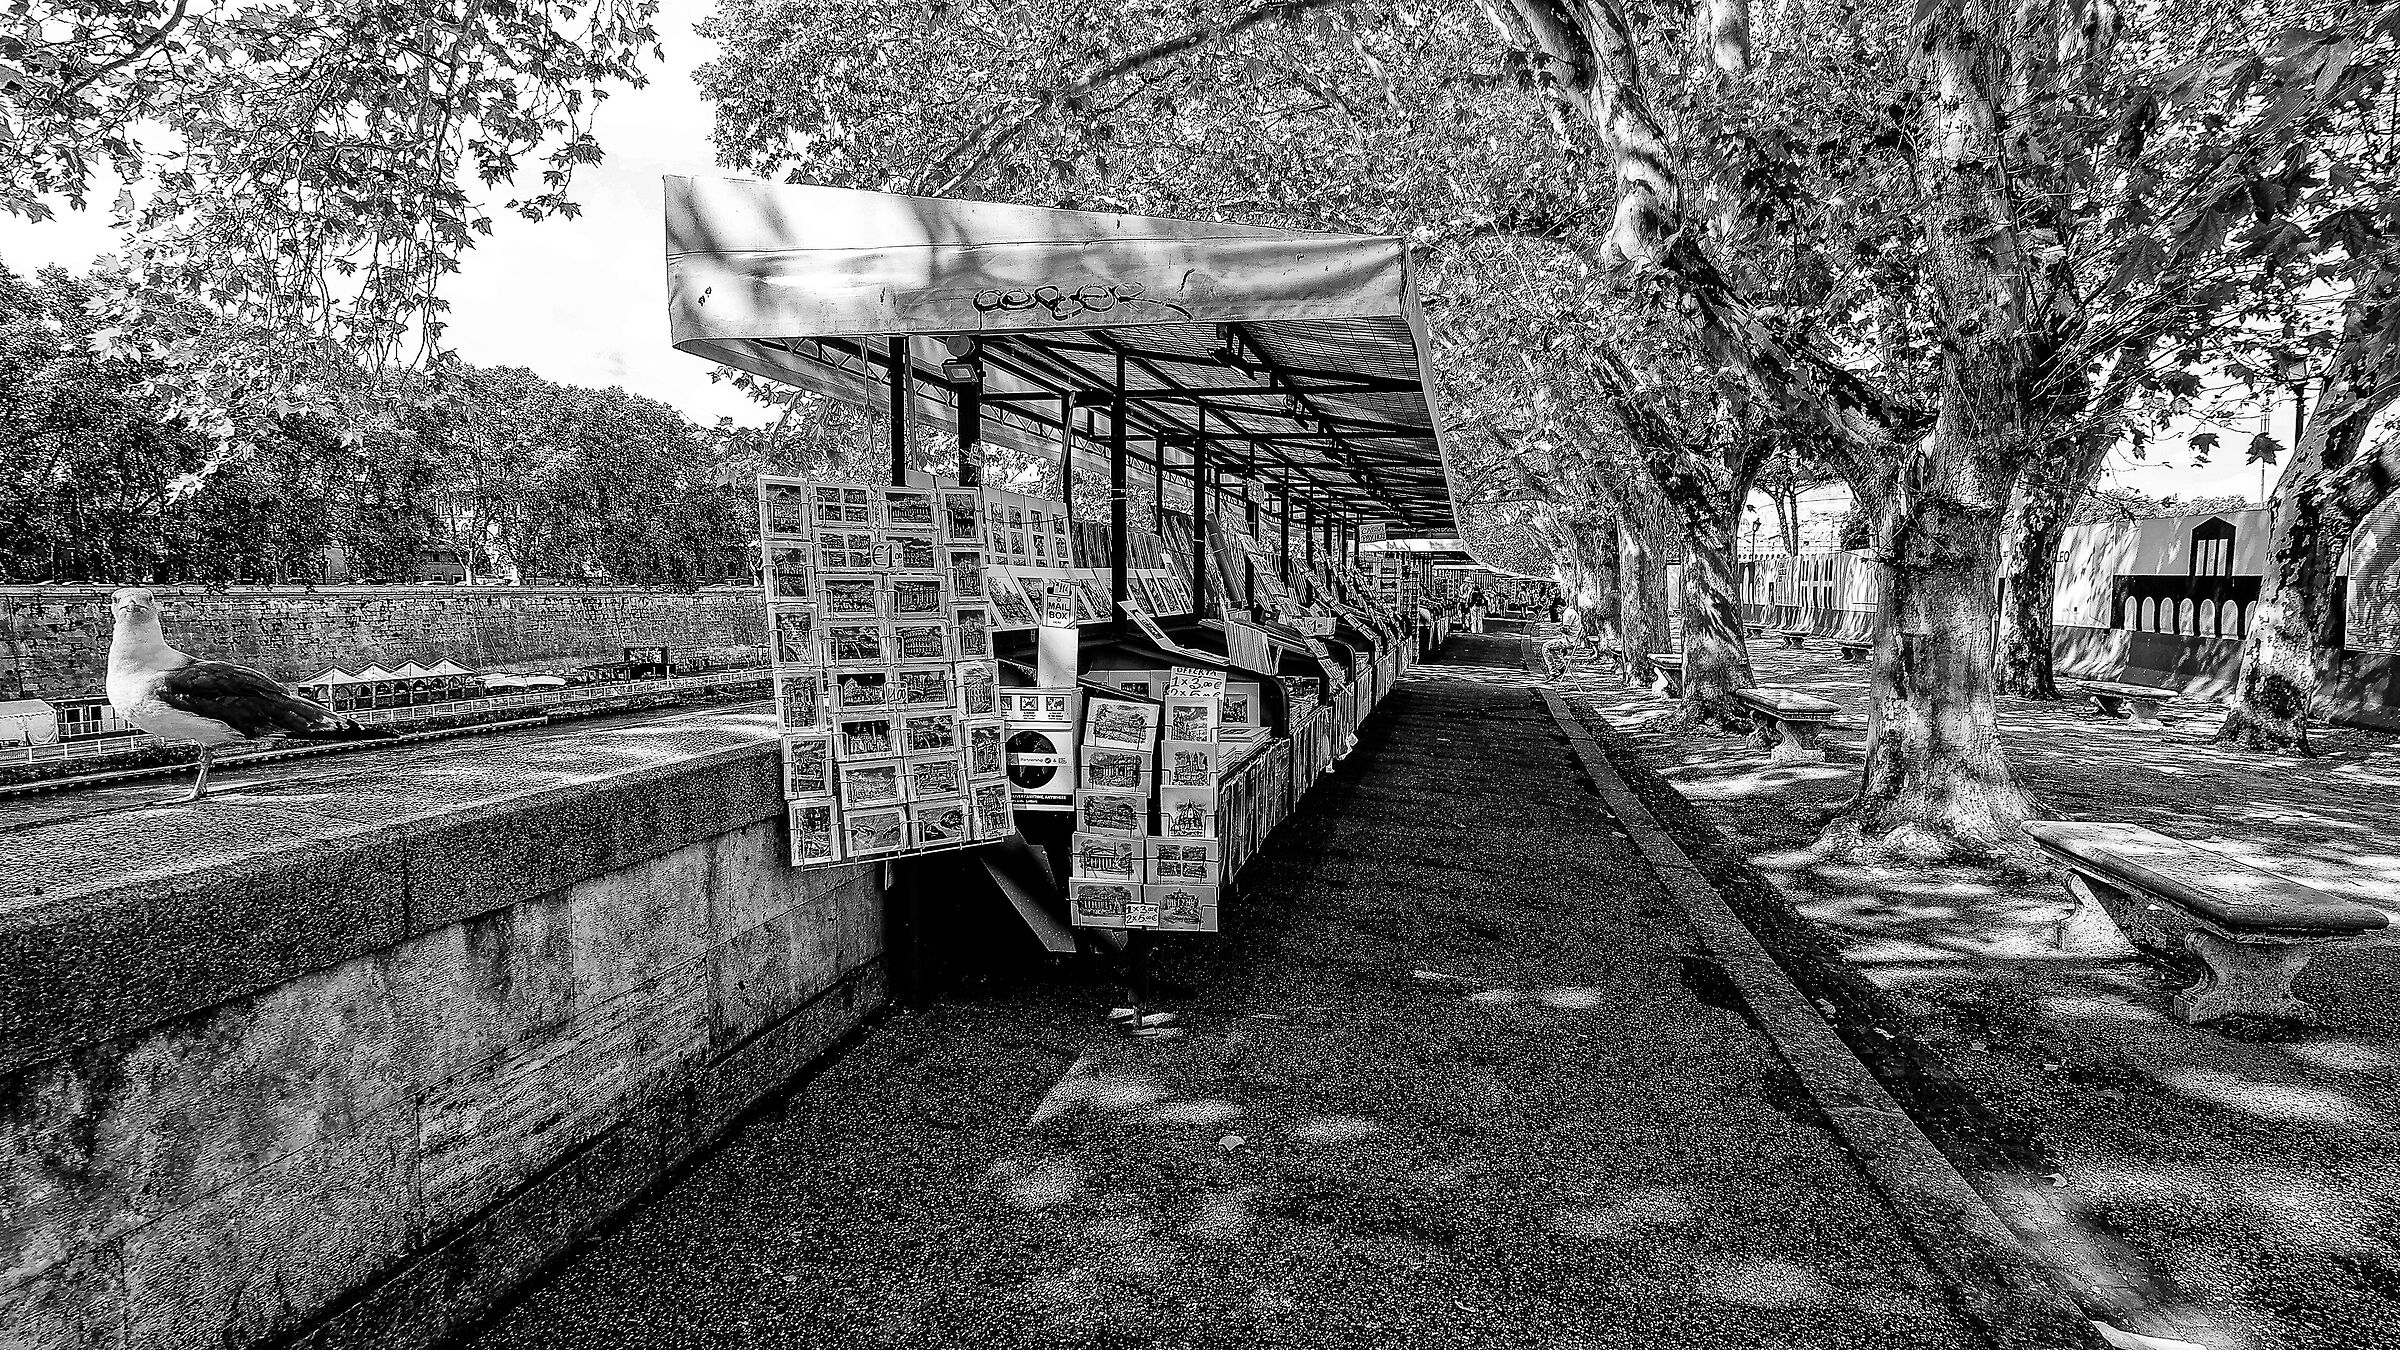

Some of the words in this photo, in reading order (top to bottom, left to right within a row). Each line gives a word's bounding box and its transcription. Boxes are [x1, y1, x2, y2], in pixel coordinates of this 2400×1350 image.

[1048, 602, 1071, 611] MAIL
[1049, 611, 1068, 620] BOX
[1176, 668, 1217, 677] OFFERTA
